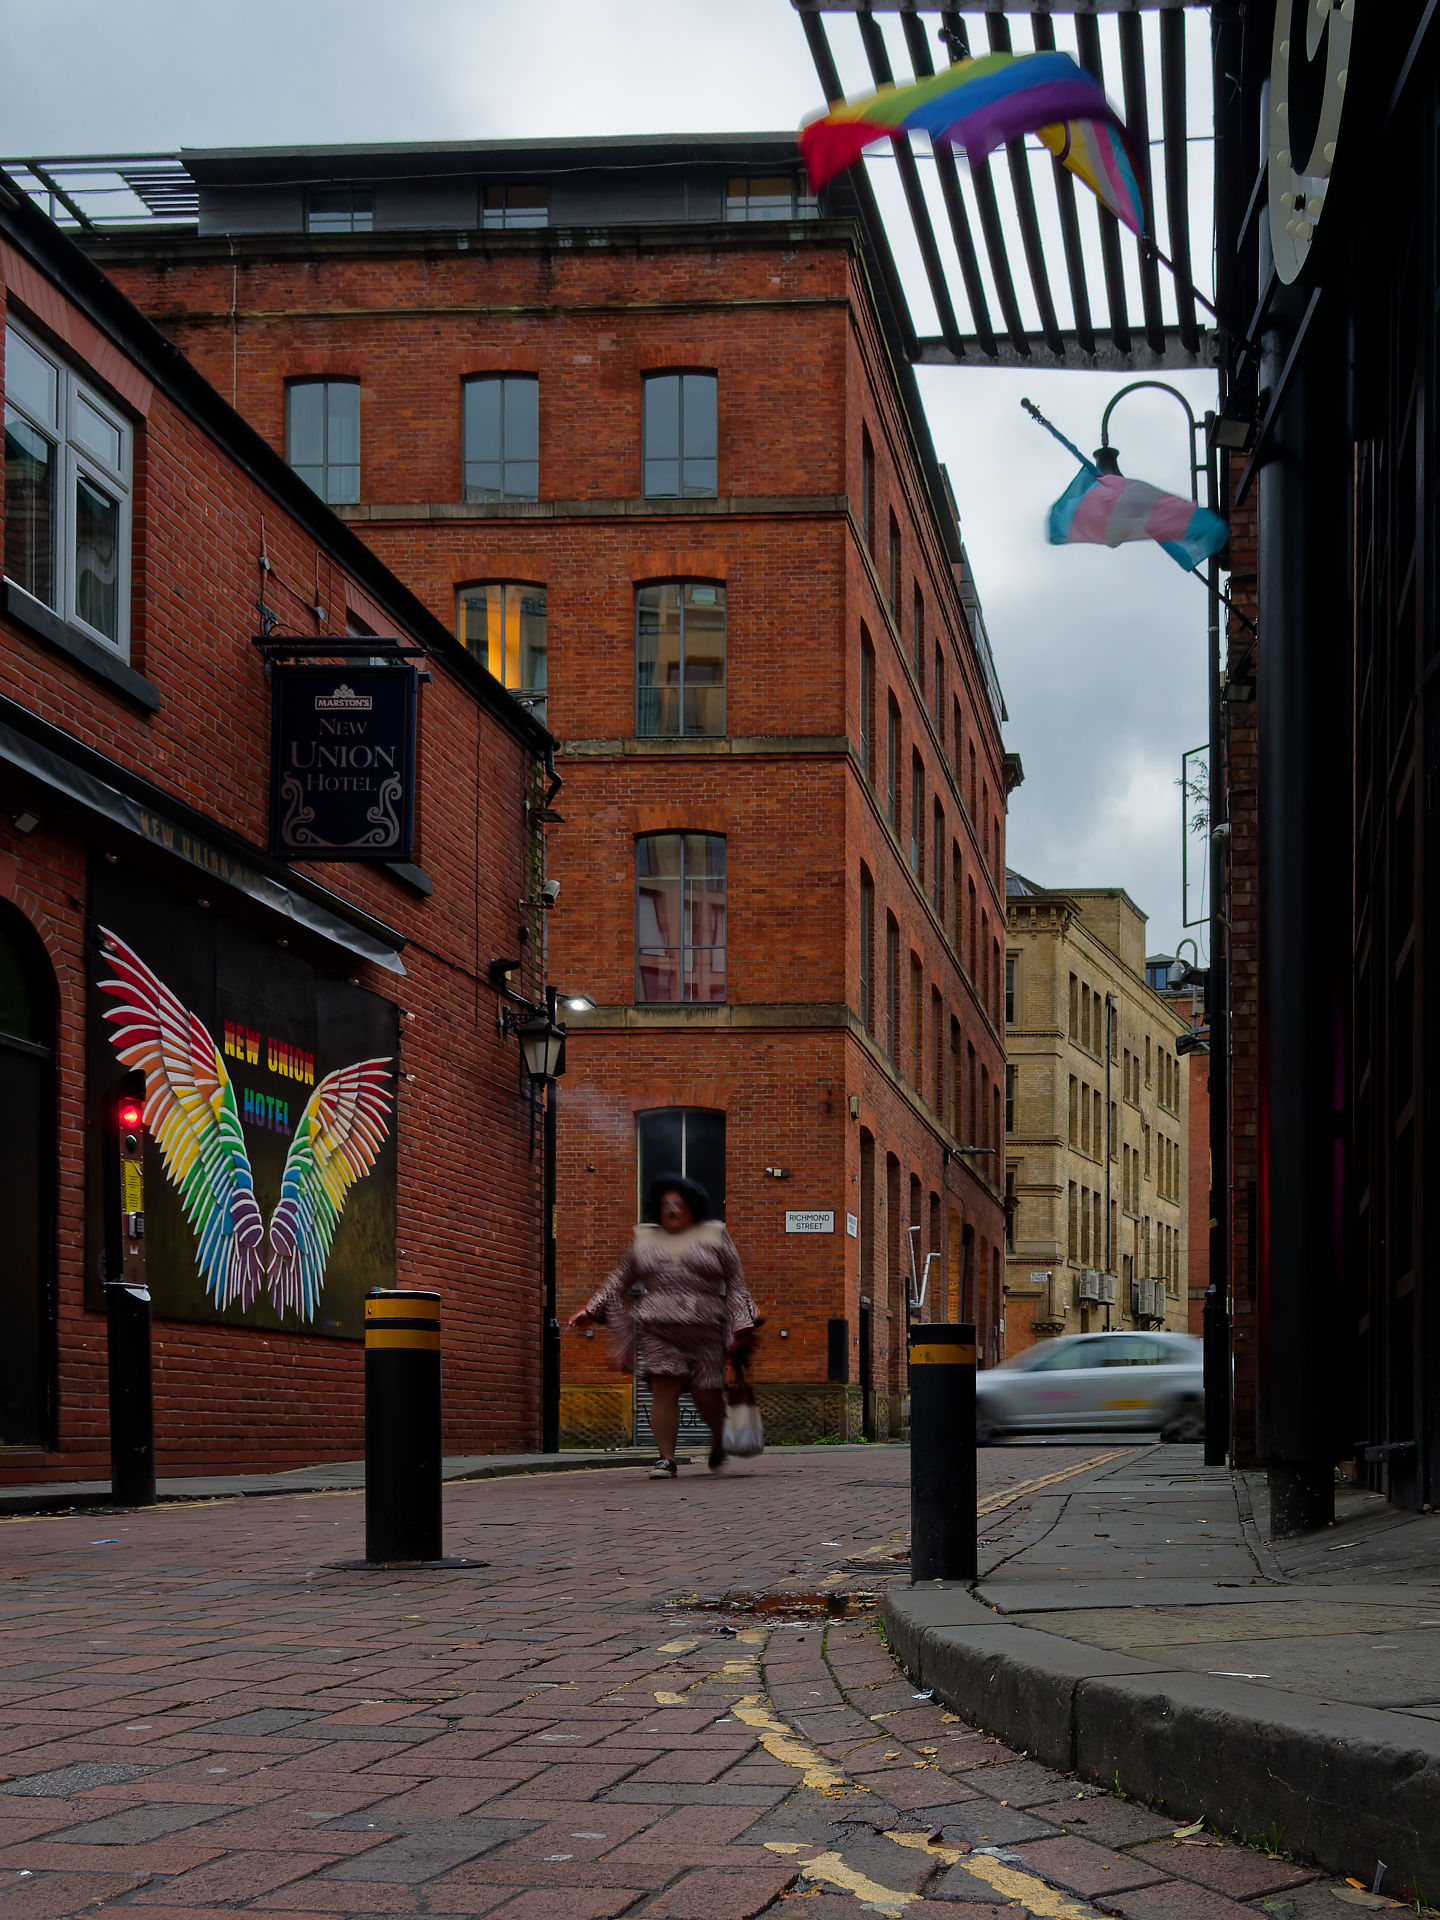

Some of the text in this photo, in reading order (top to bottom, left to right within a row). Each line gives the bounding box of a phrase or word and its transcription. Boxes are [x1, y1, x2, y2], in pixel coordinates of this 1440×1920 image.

[317, 698, 370, 708] MARSTON'S
[319, 718, 367, 736] NEW
[291, 740, 396, 768] UNION
[307, 773, 377, 791] HOTEL
[140, 811, 174, 848] NEW
[224, 1019, 314, 1087] NEW UNION
[243, 1087, 290, 1136] HOTEL
[789, 1214, 830, 1222] RICHMOND
[796, 1222, 823, 1230] STREET
